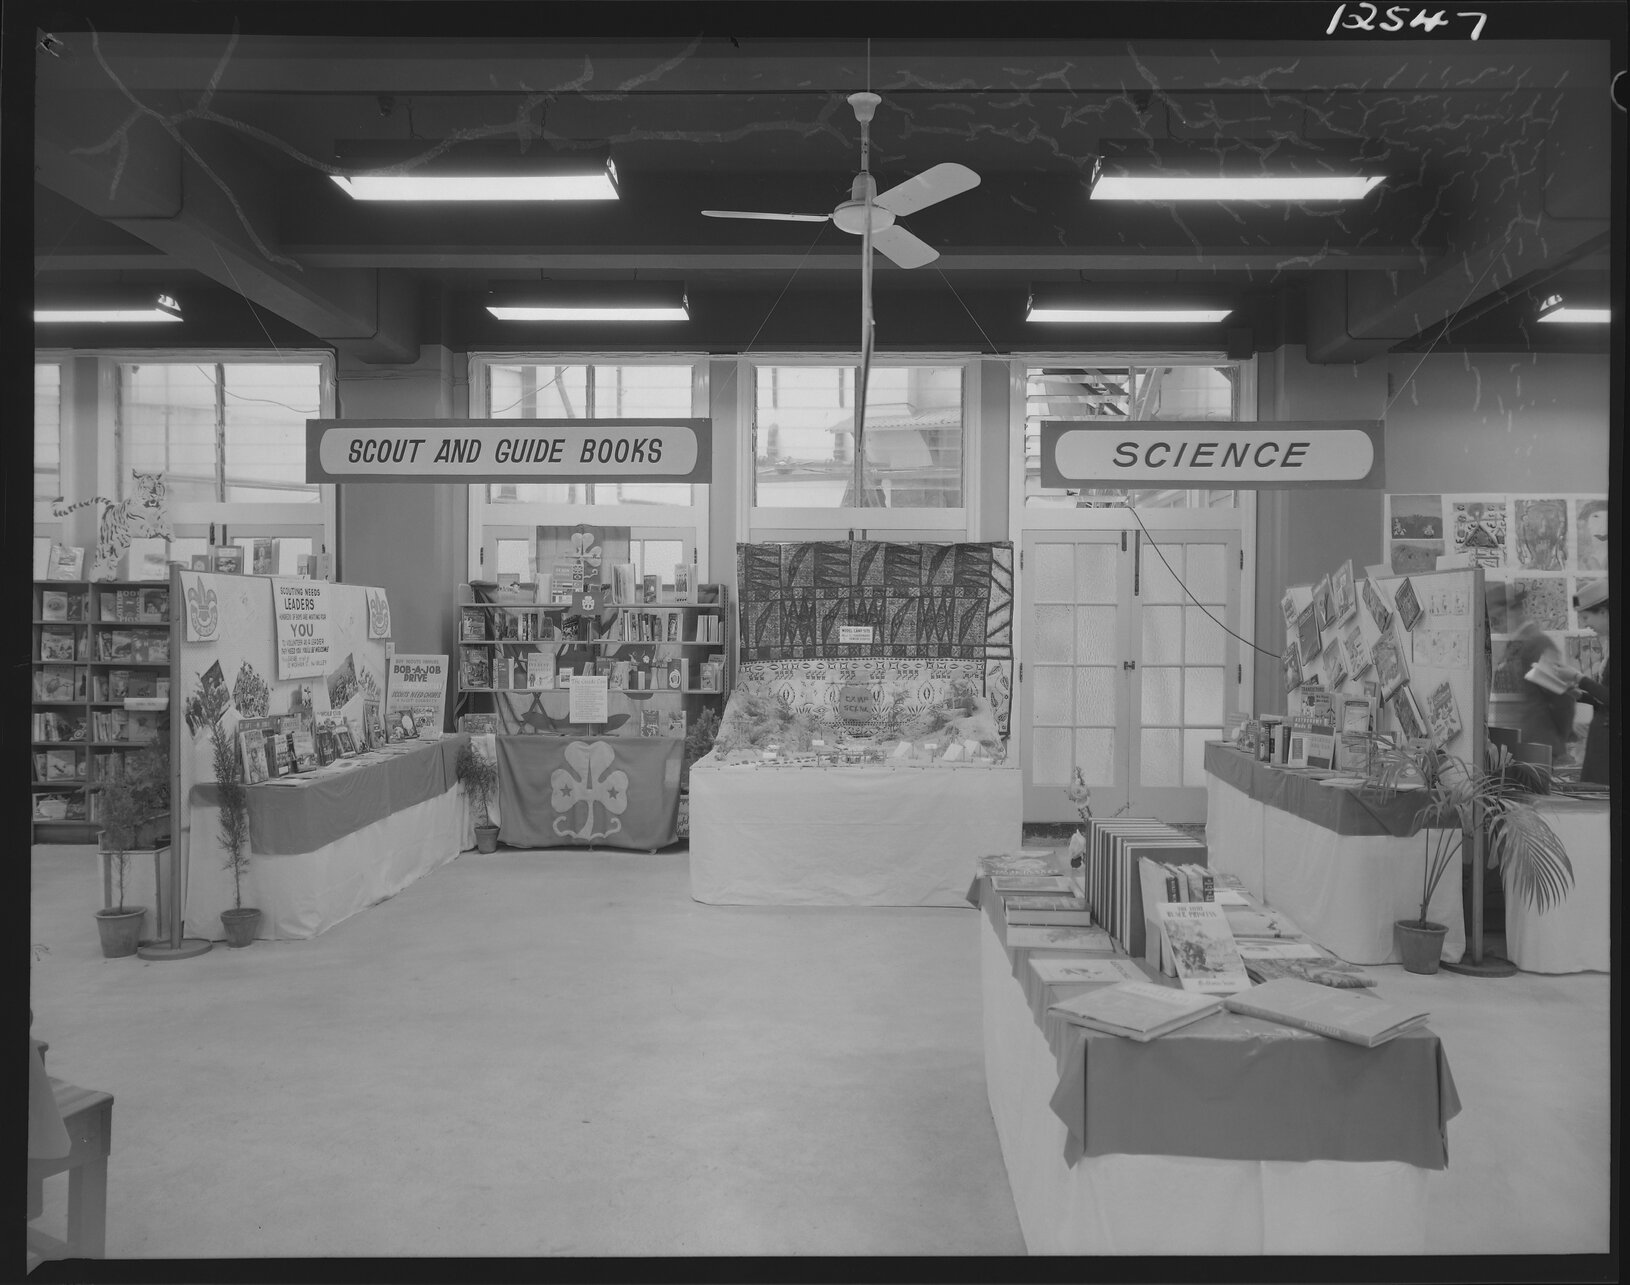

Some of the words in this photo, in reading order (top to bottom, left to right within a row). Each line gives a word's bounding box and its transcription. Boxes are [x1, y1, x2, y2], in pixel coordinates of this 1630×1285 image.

[348, 438, 426, 464] SCOUT
[433, 438, 482, 464] AND
[495, 438, 566, 464] GUIDE
[579, 438, 663, 464] BOOKS
[1112, 441, 1311, 468] SCIENCE
[280, 586, 303, 596] SCOUTING
[304, 588, 321, 596] NEEDS
[284, 598, 315, 611] LEADERS
[290, 623, 314, 637] YOU
[394, 665, 441, 674] BOB-A-JOB
[403, 673, 428, 682] DRIVE
